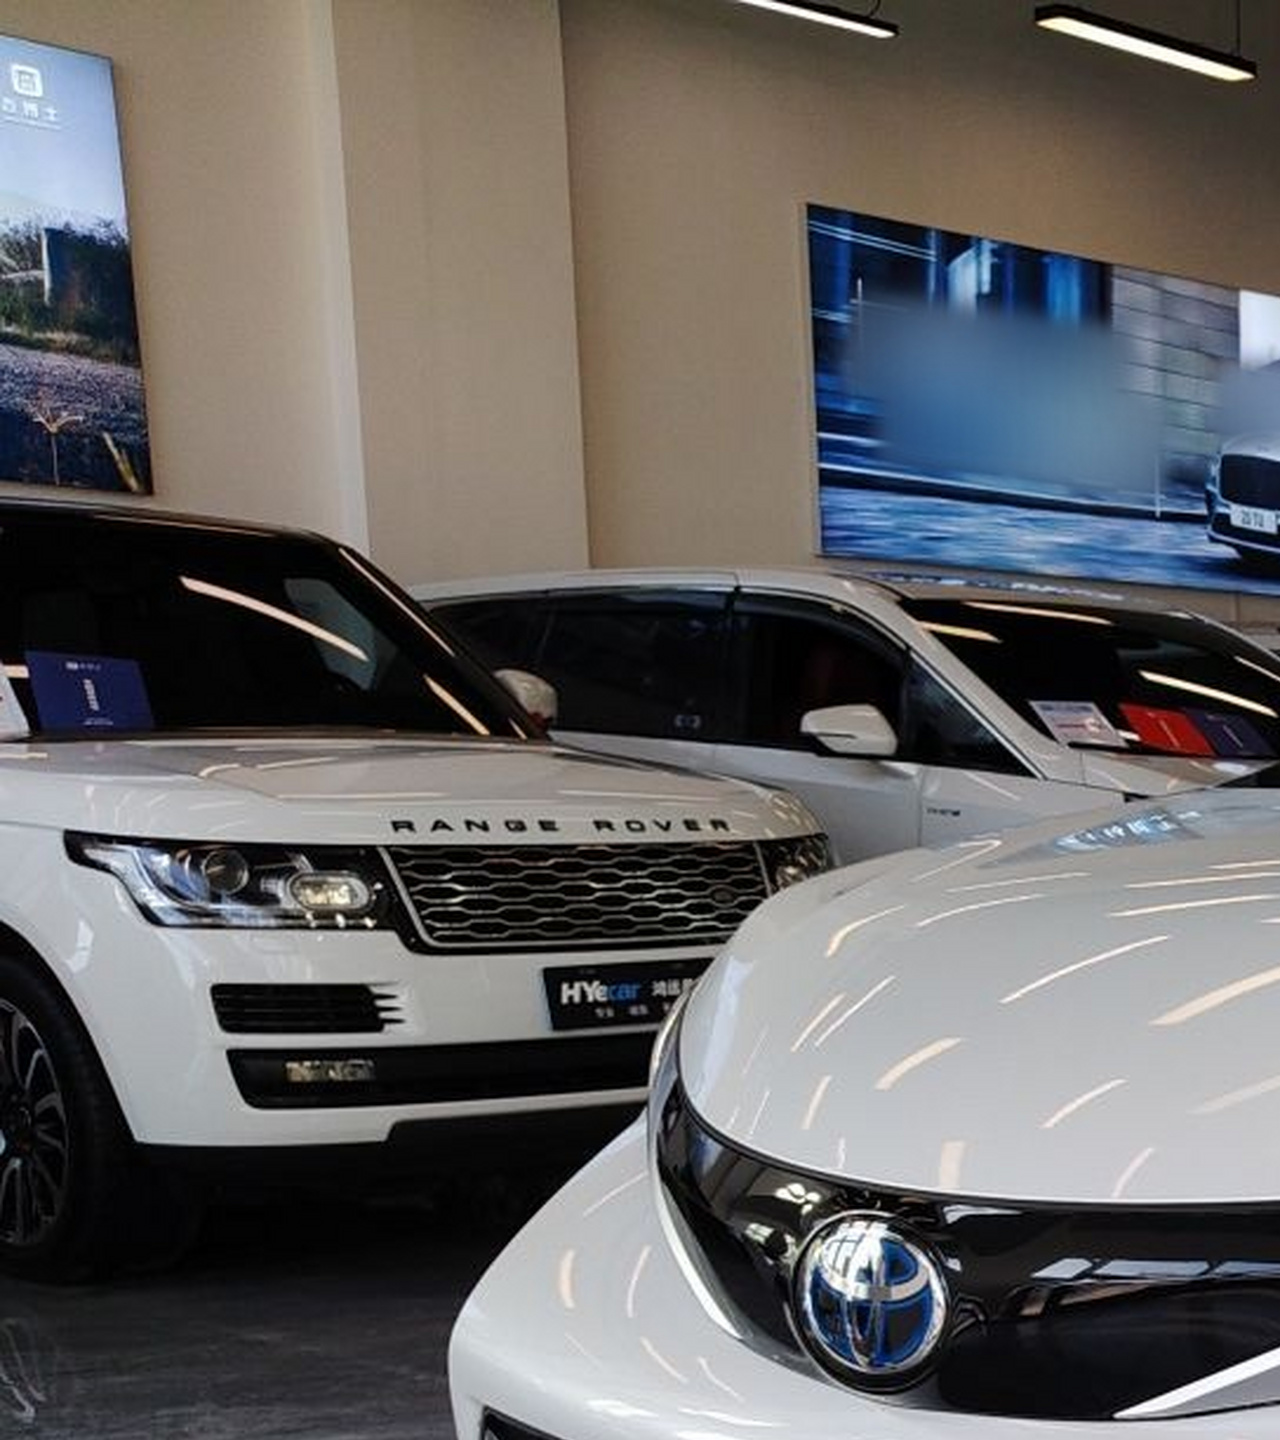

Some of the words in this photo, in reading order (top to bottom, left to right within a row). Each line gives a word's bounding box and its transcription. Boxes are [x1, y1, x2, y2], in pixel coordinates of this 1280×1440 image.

[390, 819, 560, 833] RANGE
[592, 818, 731, 833] ROVER
[560, 979, 642, 1005] HYecar
